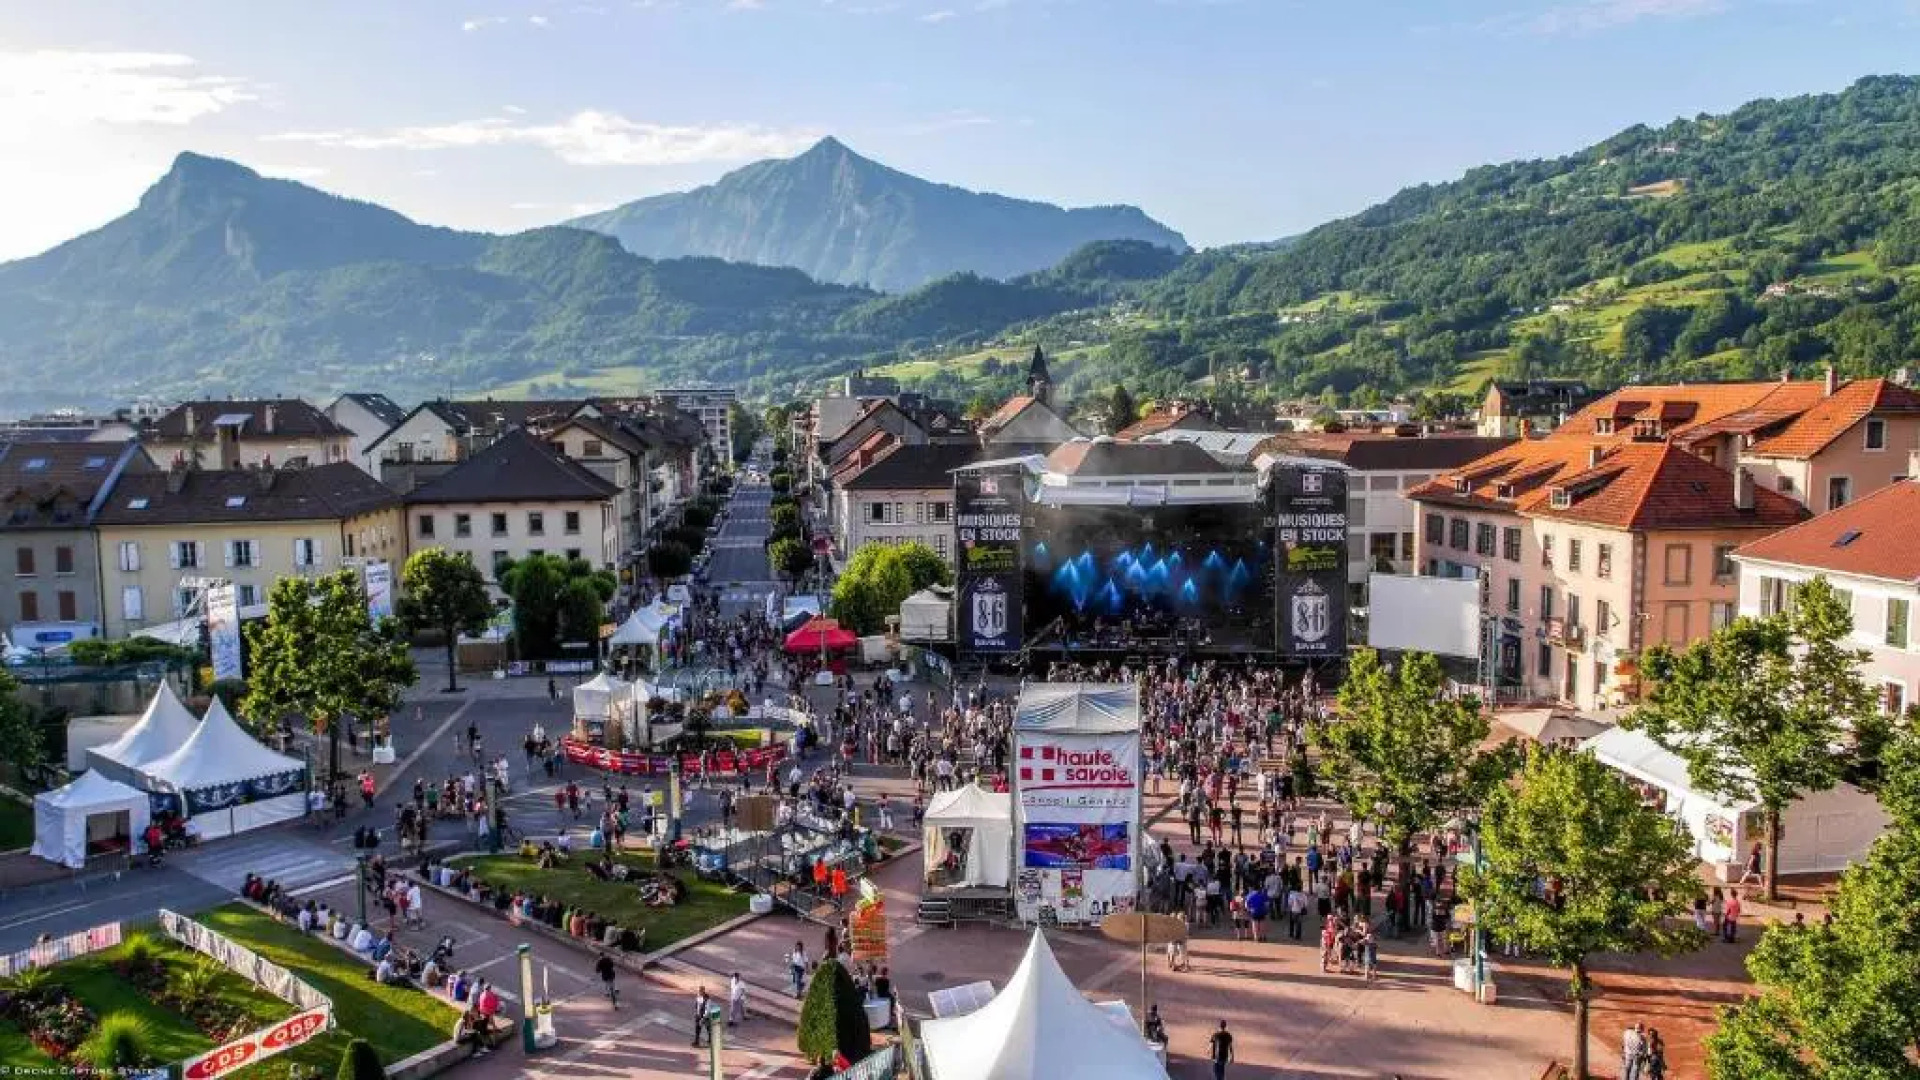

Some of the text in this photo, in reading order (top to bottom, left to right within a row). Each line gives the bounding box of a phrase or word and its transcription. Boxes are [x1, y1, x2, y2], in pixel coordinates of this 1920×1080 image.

[958, 513, 1021, 527] MUSIQUES
[1278, 513, 1345, 527] MUSIQUES
[961, 528, 1021, 541] EN STOCK
[1281, 528, 1345, 541] EN STOCK
[1056, 747, 1113, 766] haute
